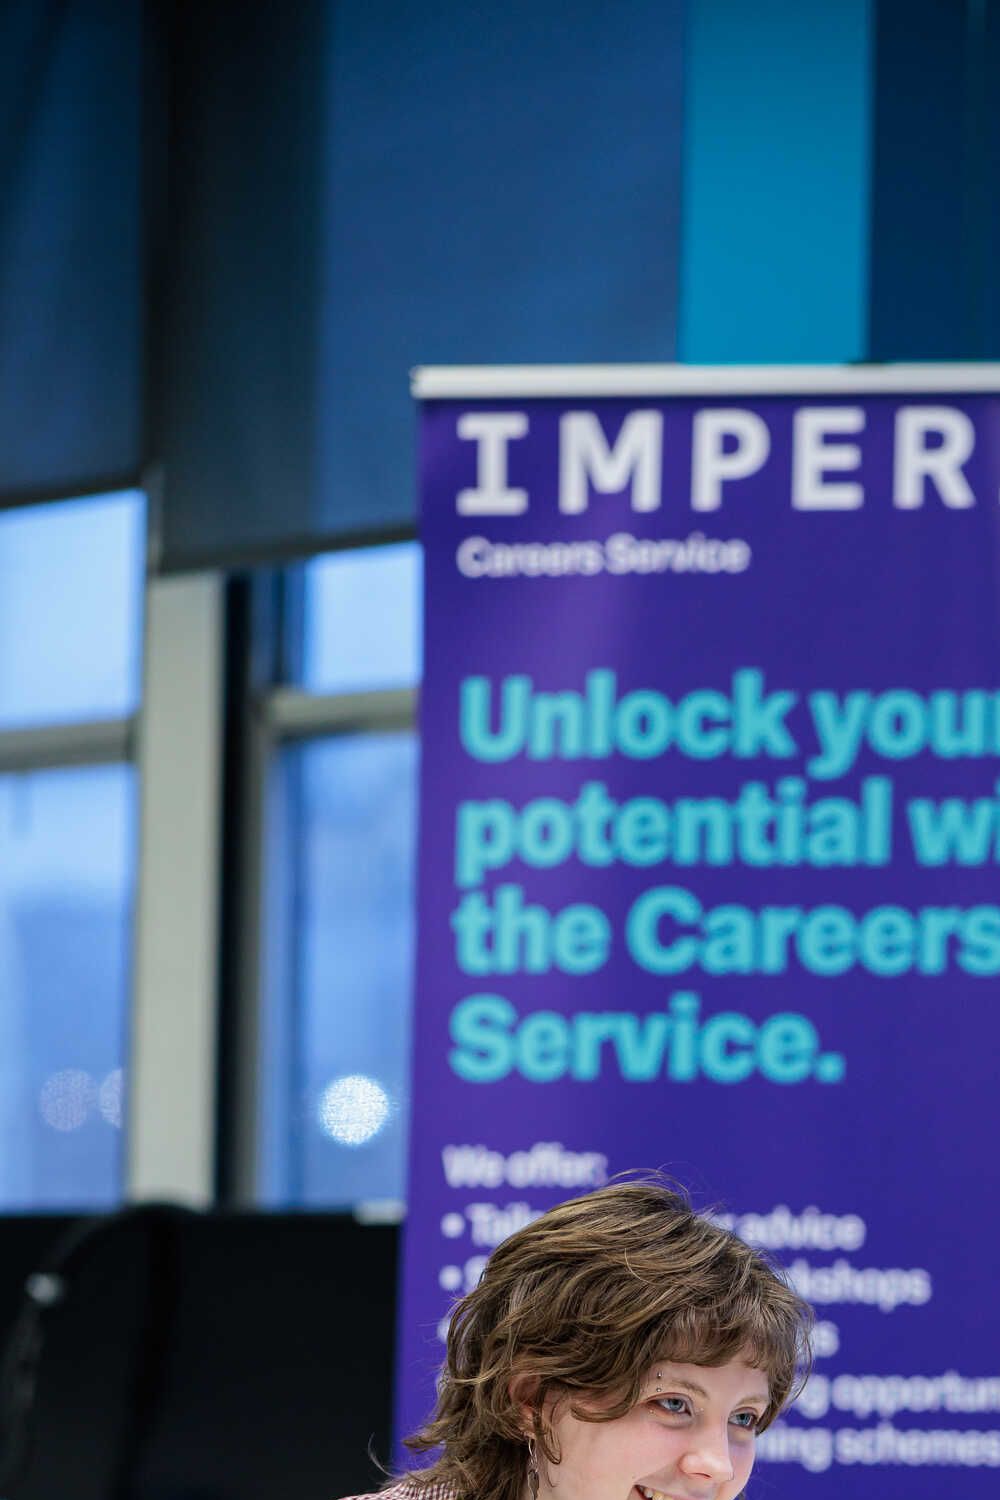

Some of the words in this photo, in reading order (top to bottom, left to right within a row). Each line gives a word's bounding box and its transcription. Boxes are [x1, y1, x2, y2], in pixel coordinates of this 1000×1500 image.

[457, 537, 603, 576] Careers
[604, 532, 750, 574] Service
[461, 669, 797, 761] Unlock
[455, 776, 892, 887] potential
[451, 886, 610, 975] the
[449, 992, 845, 1083] Service.
[443, 1145, 502, 1188] We
[736, 1205, 867, 1251] advice
